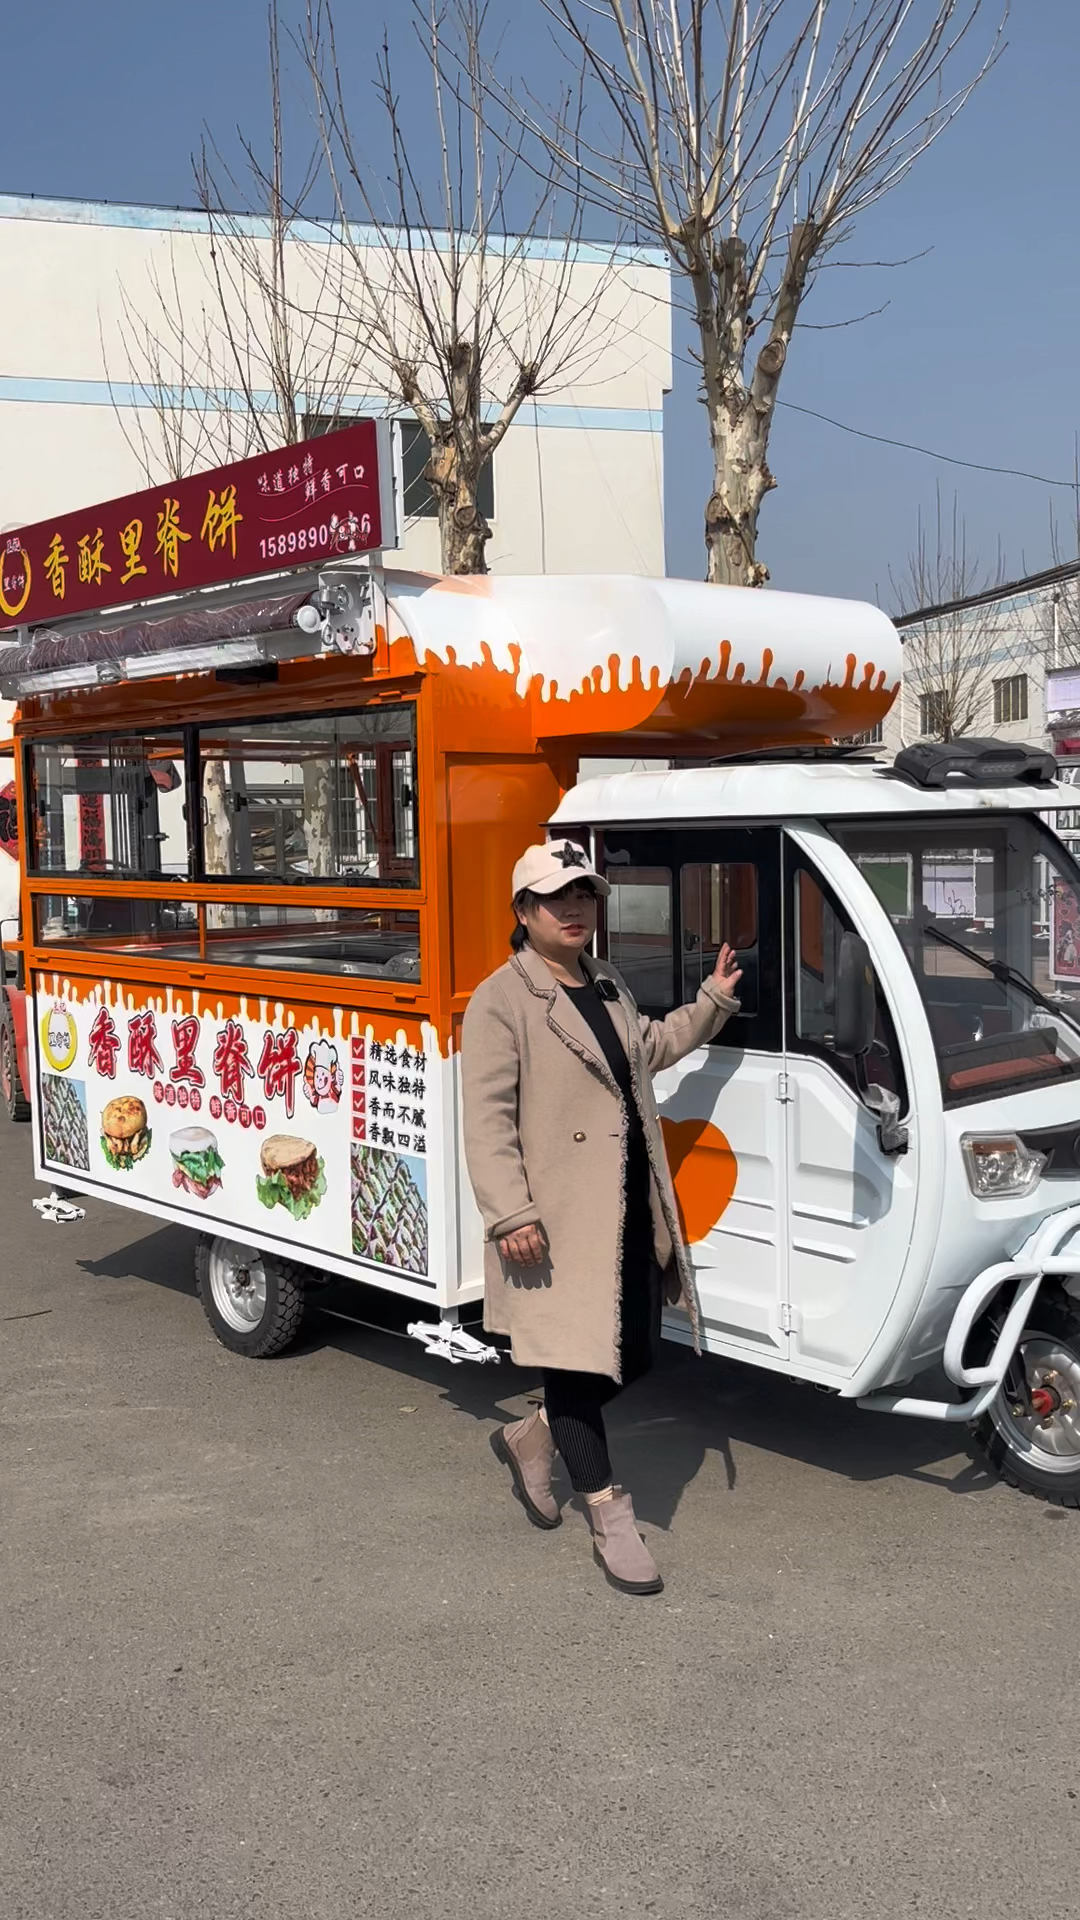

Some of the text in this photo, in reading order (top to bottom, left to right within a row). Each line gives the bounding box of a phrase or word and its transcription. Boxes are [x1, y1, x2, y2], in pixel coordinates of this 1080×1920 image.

[257, 452, 314, 493] 味道独特
[304, 462, 365, 502] 鲜香可口
[43, 484, 244, 600] 香酥里脊饼
[259, 513, 371, 559] 15898906
[88, 1006, 303, 1118] 香酥里脊饼
[369, 1041, 427, 1072] 精选食材
[368, 1070, 427, 1100] 风味独特
[153, 1081, 267, 1130] 味道独特 鲜香可口
[368, 1096, 427, 1129] 香而不腻
[368, 1122, 427, 1153] 香飘四溢
